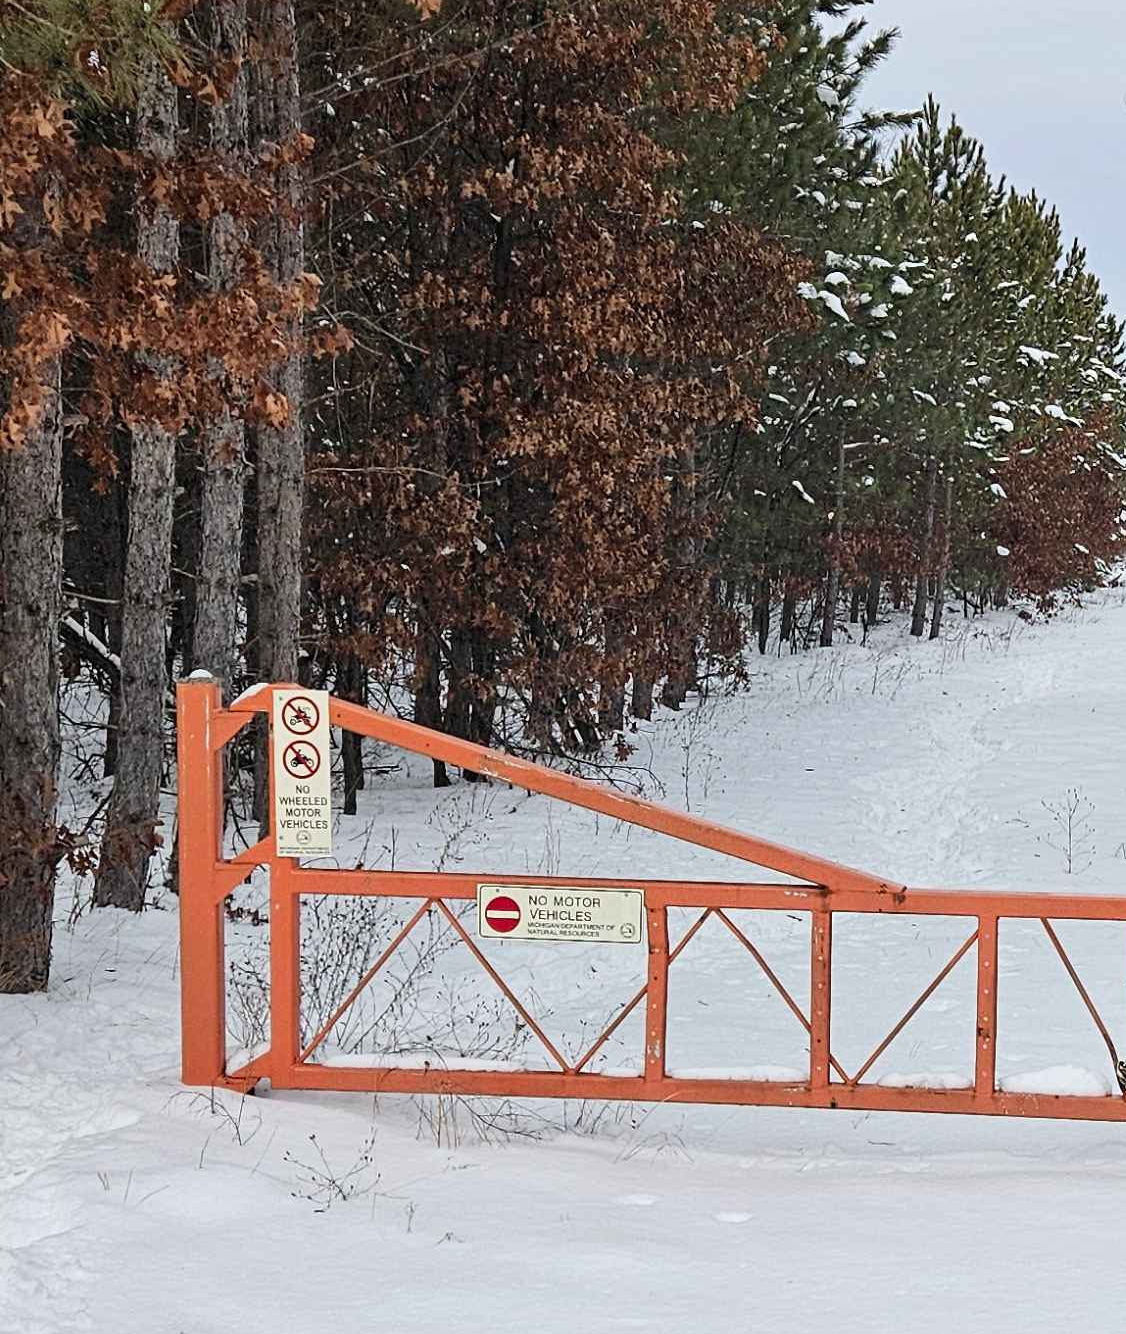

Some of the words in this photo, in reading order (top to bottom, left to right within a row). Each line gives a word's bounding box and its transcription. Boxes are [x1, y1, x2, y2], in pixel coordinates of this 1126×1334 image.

[296, 785, 310, 794] NO
[280, 796, 328, 806] WHEELED
[286, 808, 321, 817] MOTOR
[280, 820, 328, 829] VEHICLES
[528, 895, 547, 906] NO
[553, 896, 600, 907] MOTOR
[529, 908, 592, 921] VEHICLES
